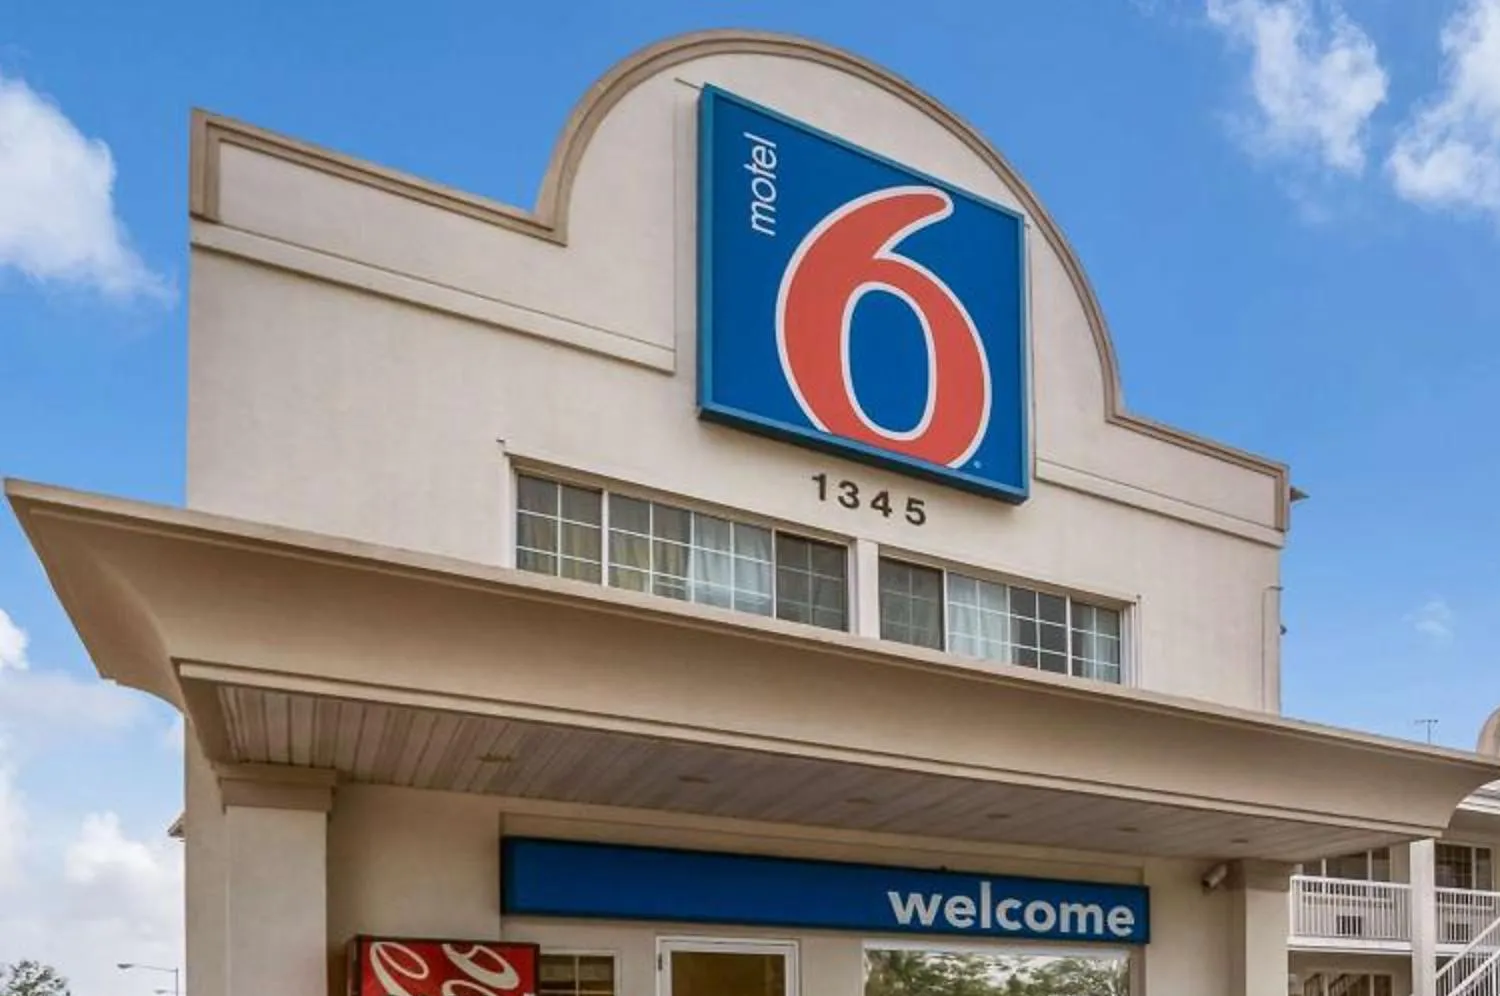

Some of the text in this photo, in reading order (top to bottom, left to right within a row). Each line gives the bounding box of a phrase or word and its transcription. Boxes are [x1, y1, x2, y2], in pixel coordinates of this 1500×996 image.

[744, 131, 777, 237] motel
[775, 185, 993, 469] 6
[811, 472, 927, 527] 1345
[887, 880, 1136, 937] welcome
